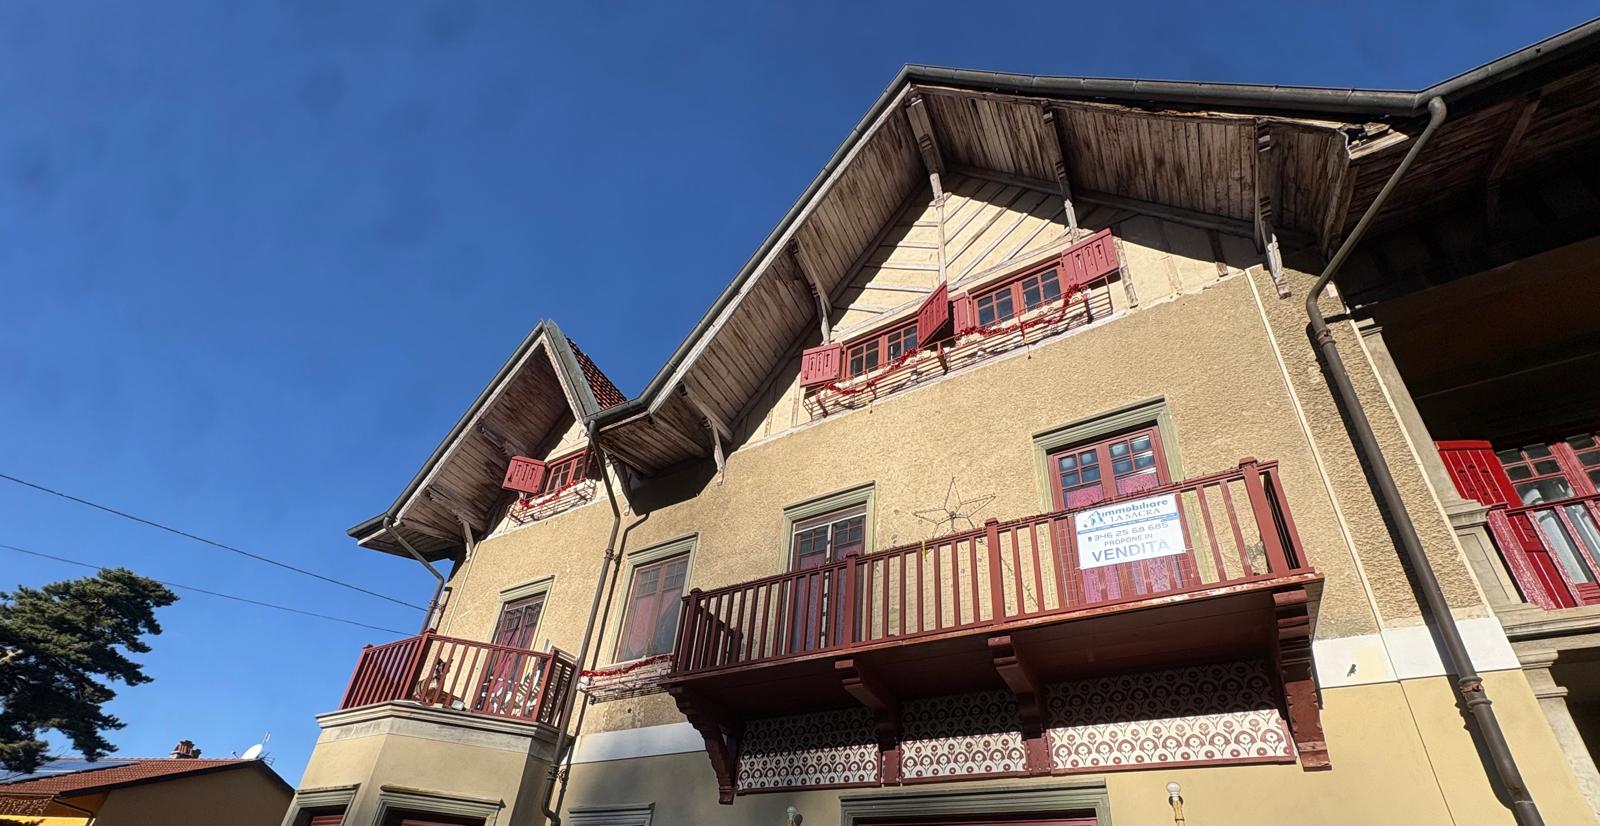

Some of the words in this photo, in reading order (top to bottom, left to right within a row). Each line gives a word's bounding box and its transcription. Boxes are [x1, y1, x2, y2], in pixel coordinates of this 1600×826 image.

[1102, 499, 1168, 517] immobiliare
[1126, 508, 1161, 520] SACRA
[1104, 534, 1143, 547] PROPONE
[1145, 532, 1153, 540] IN
[1116, 529, 1129, 537] 25
[1091, 539, 1169, 562] VENDITÀ
